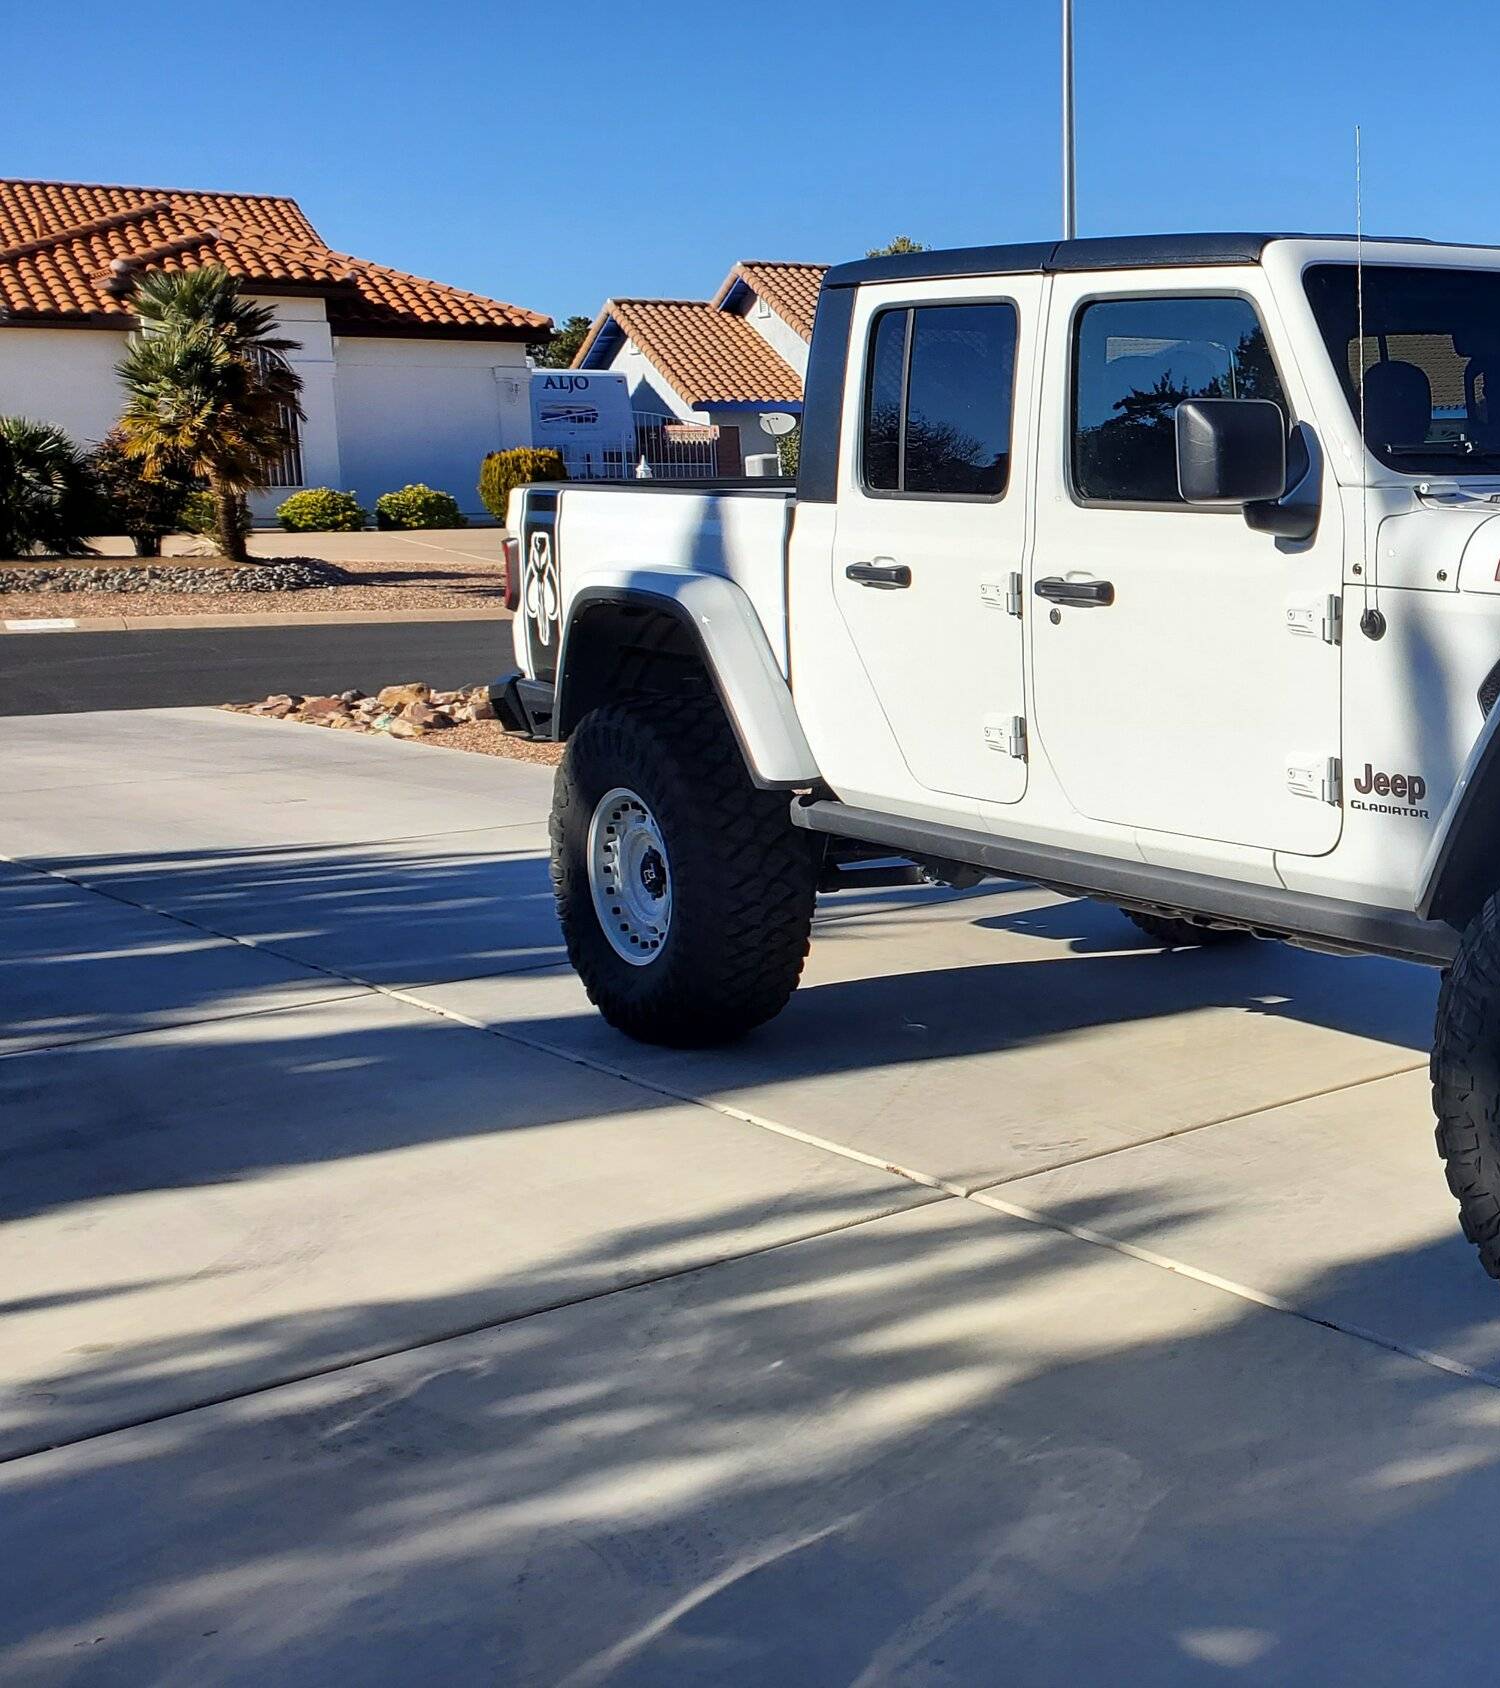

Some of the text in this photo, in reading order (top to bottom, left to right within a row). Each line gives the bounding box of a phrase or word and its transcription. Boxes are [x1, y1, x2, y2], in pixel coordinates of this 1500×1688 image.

[543, 376, 590, 393] ALJO
[1354, 763, 1426, 805] Jeep
[1350, 799, 1430, 819] GLADIATOR
